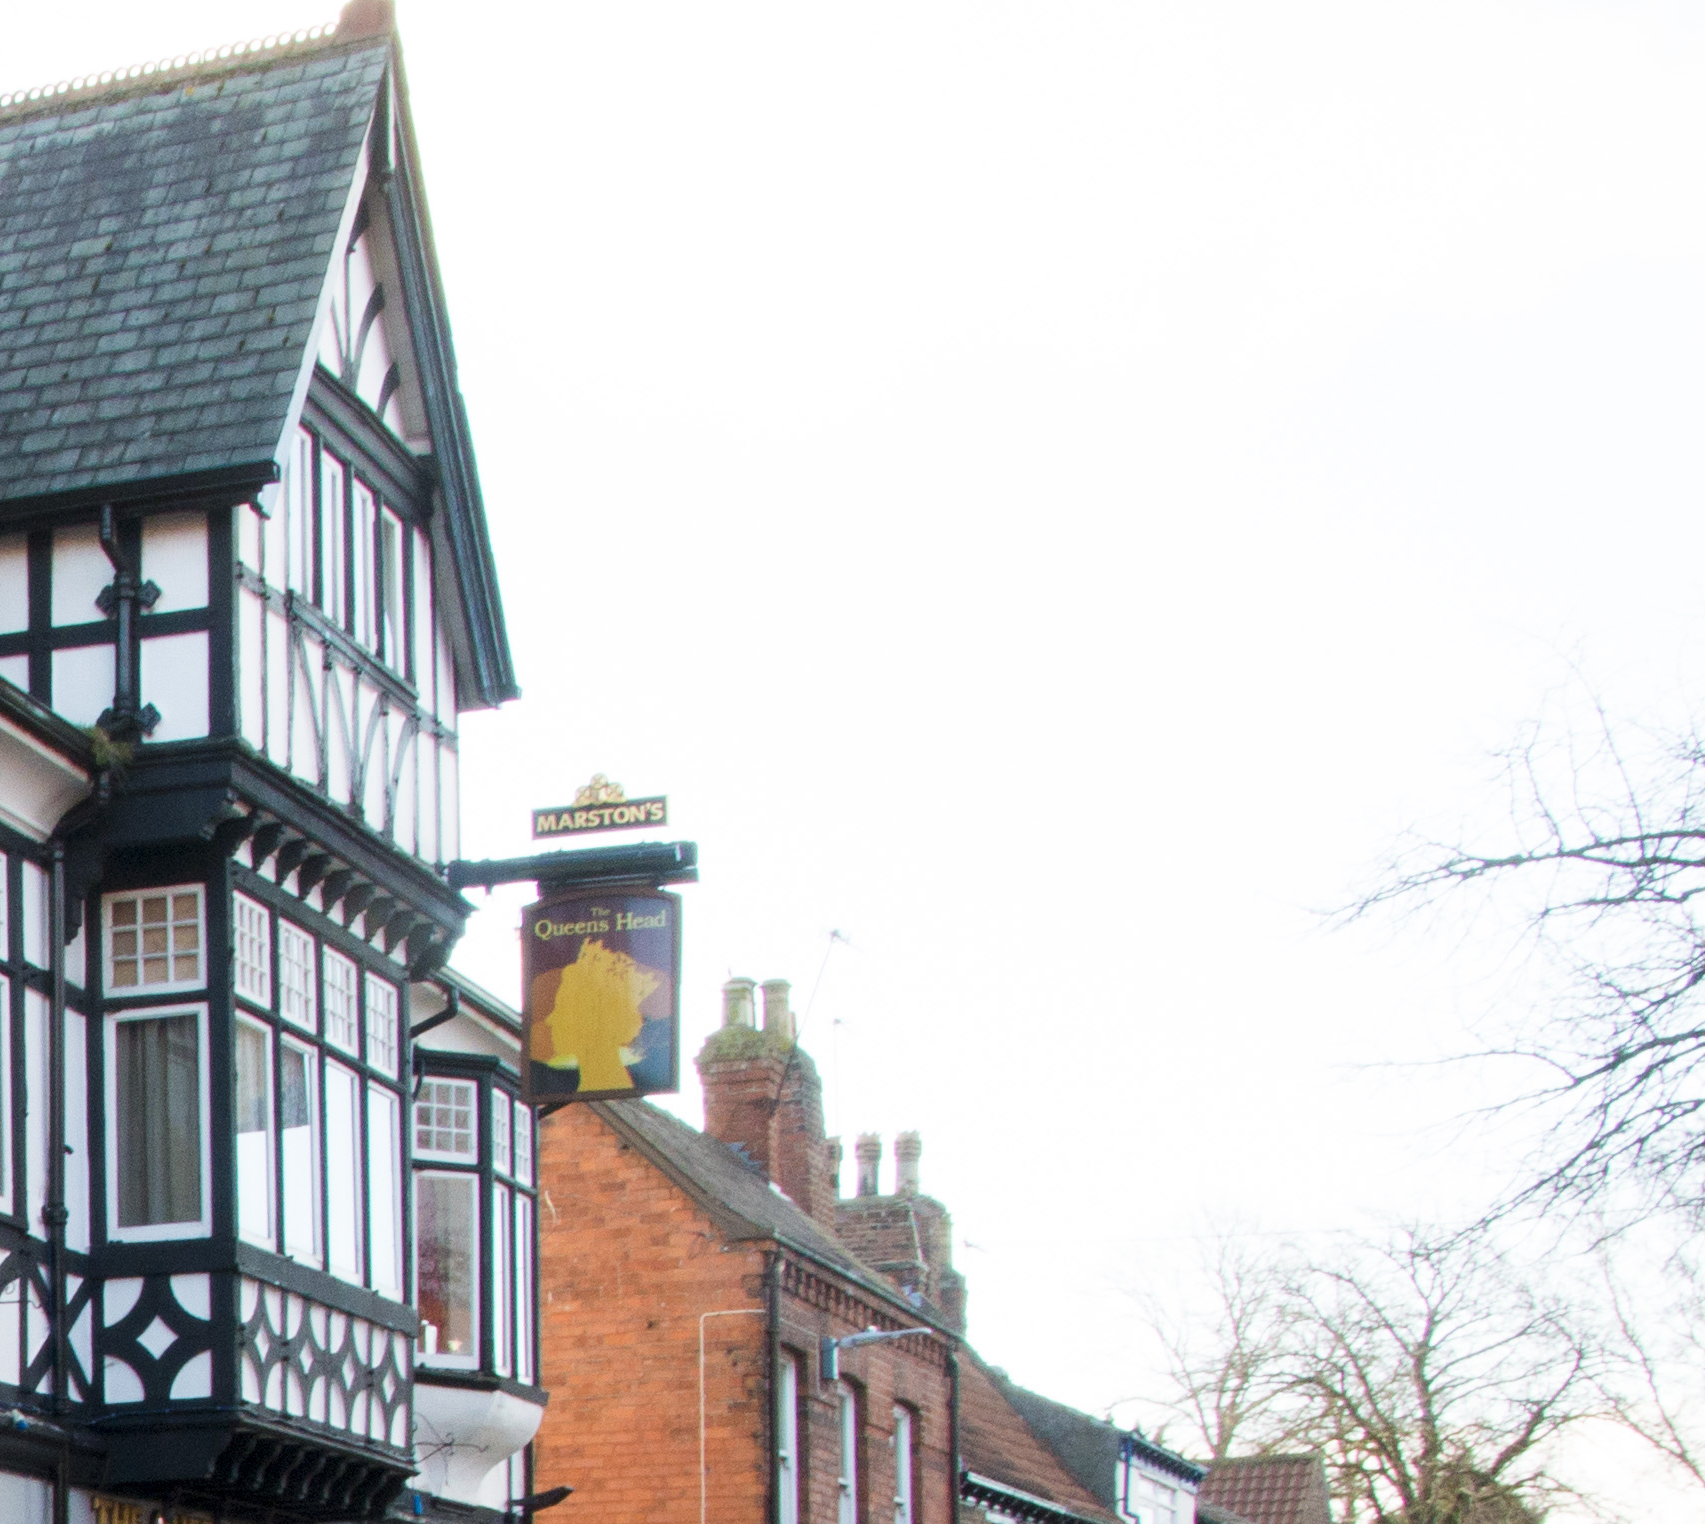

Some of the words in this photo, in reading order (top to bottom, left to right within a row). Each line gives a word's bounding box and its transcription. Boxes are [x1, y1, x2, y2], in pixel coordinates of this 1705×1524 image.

[536, 801, 664, 833] MARSTON'S
[535, 917, 609, 941] Queens
[616, 909, 666, 931] Head
[590, 906, 610, 918] The
